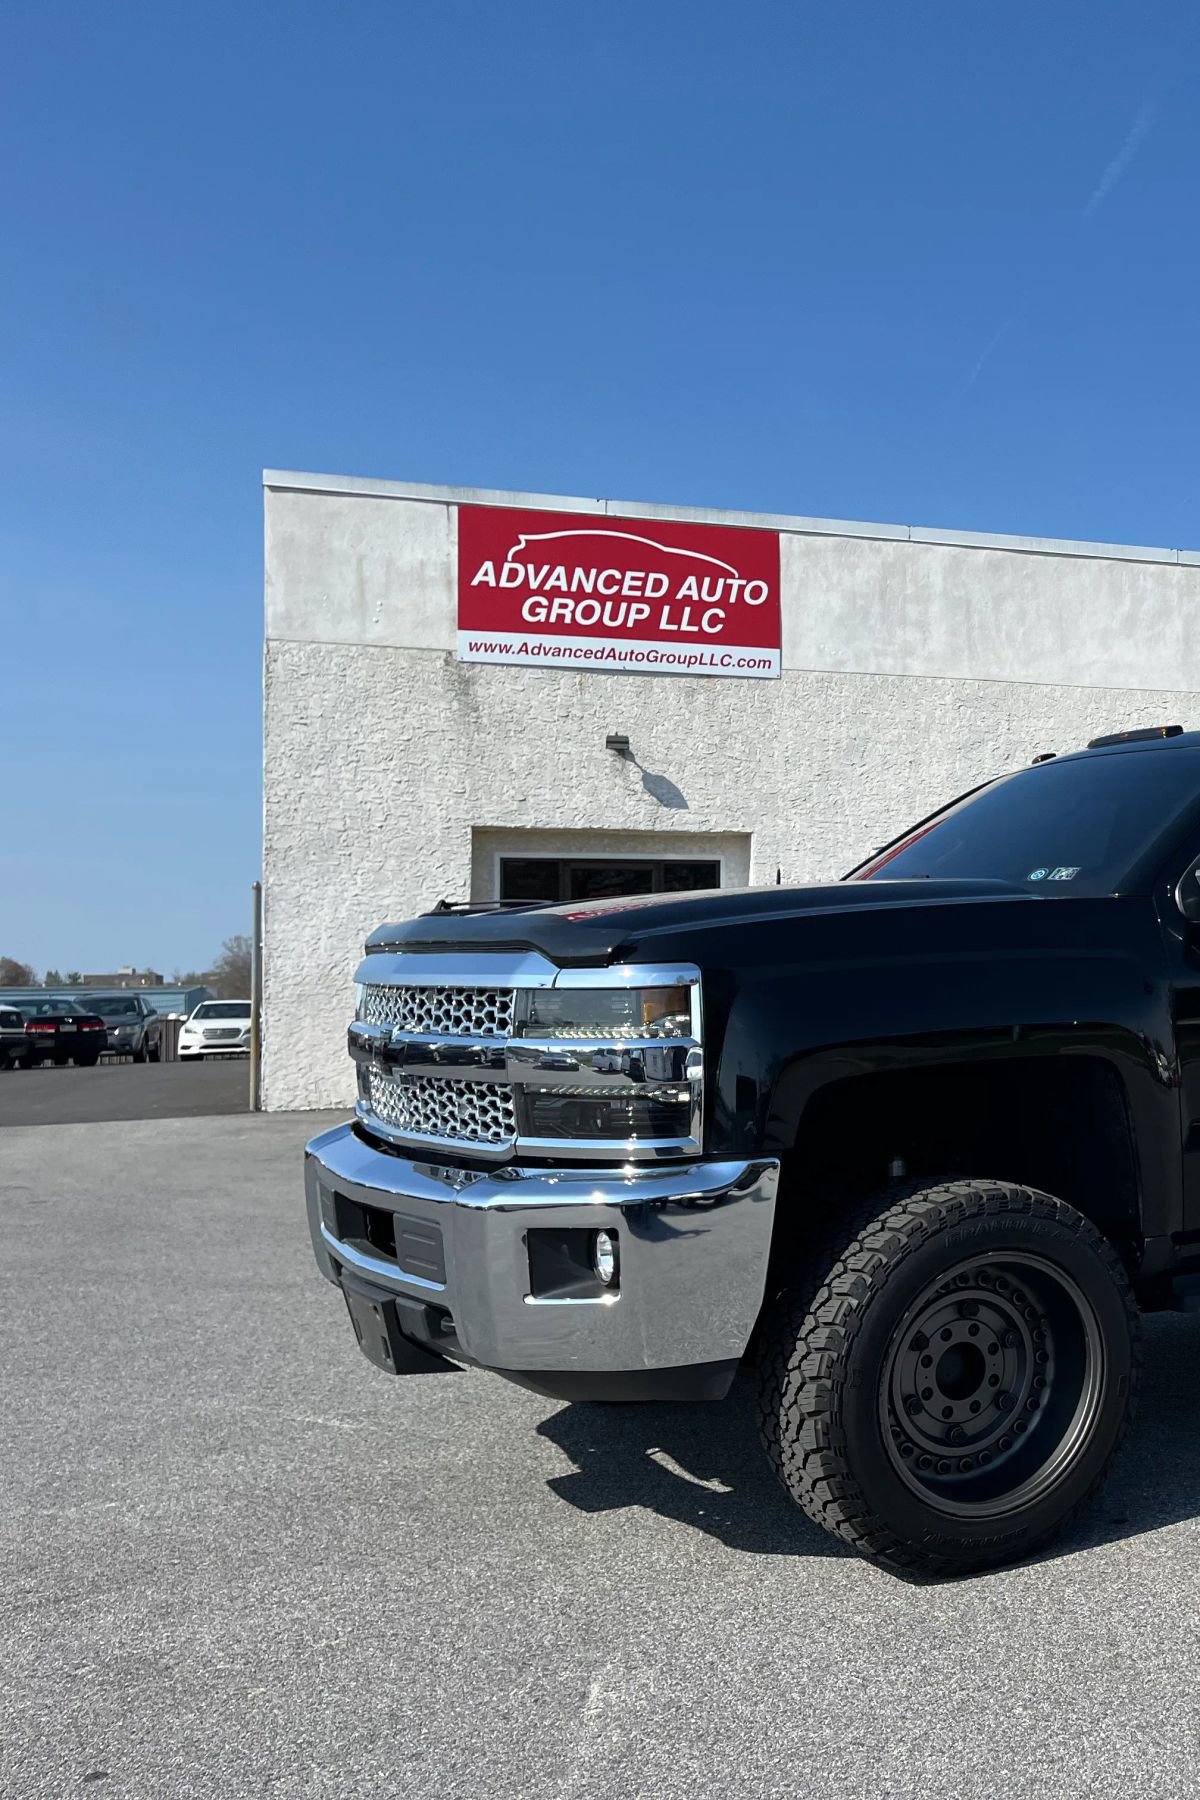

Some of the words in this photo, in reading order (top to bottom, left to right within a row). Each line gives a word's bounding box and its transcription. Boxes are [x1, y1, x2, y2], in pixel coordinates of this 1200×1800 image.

[470, 560, 669, 599] ADVANCED
[675, 575, 769, 606] AUTO
[521, 596, 650, 628] GROUP
[659, 605, 726, 633] LLC
[468, 641, 772, 670] www.AdvancedAutoGroupLLC.com
